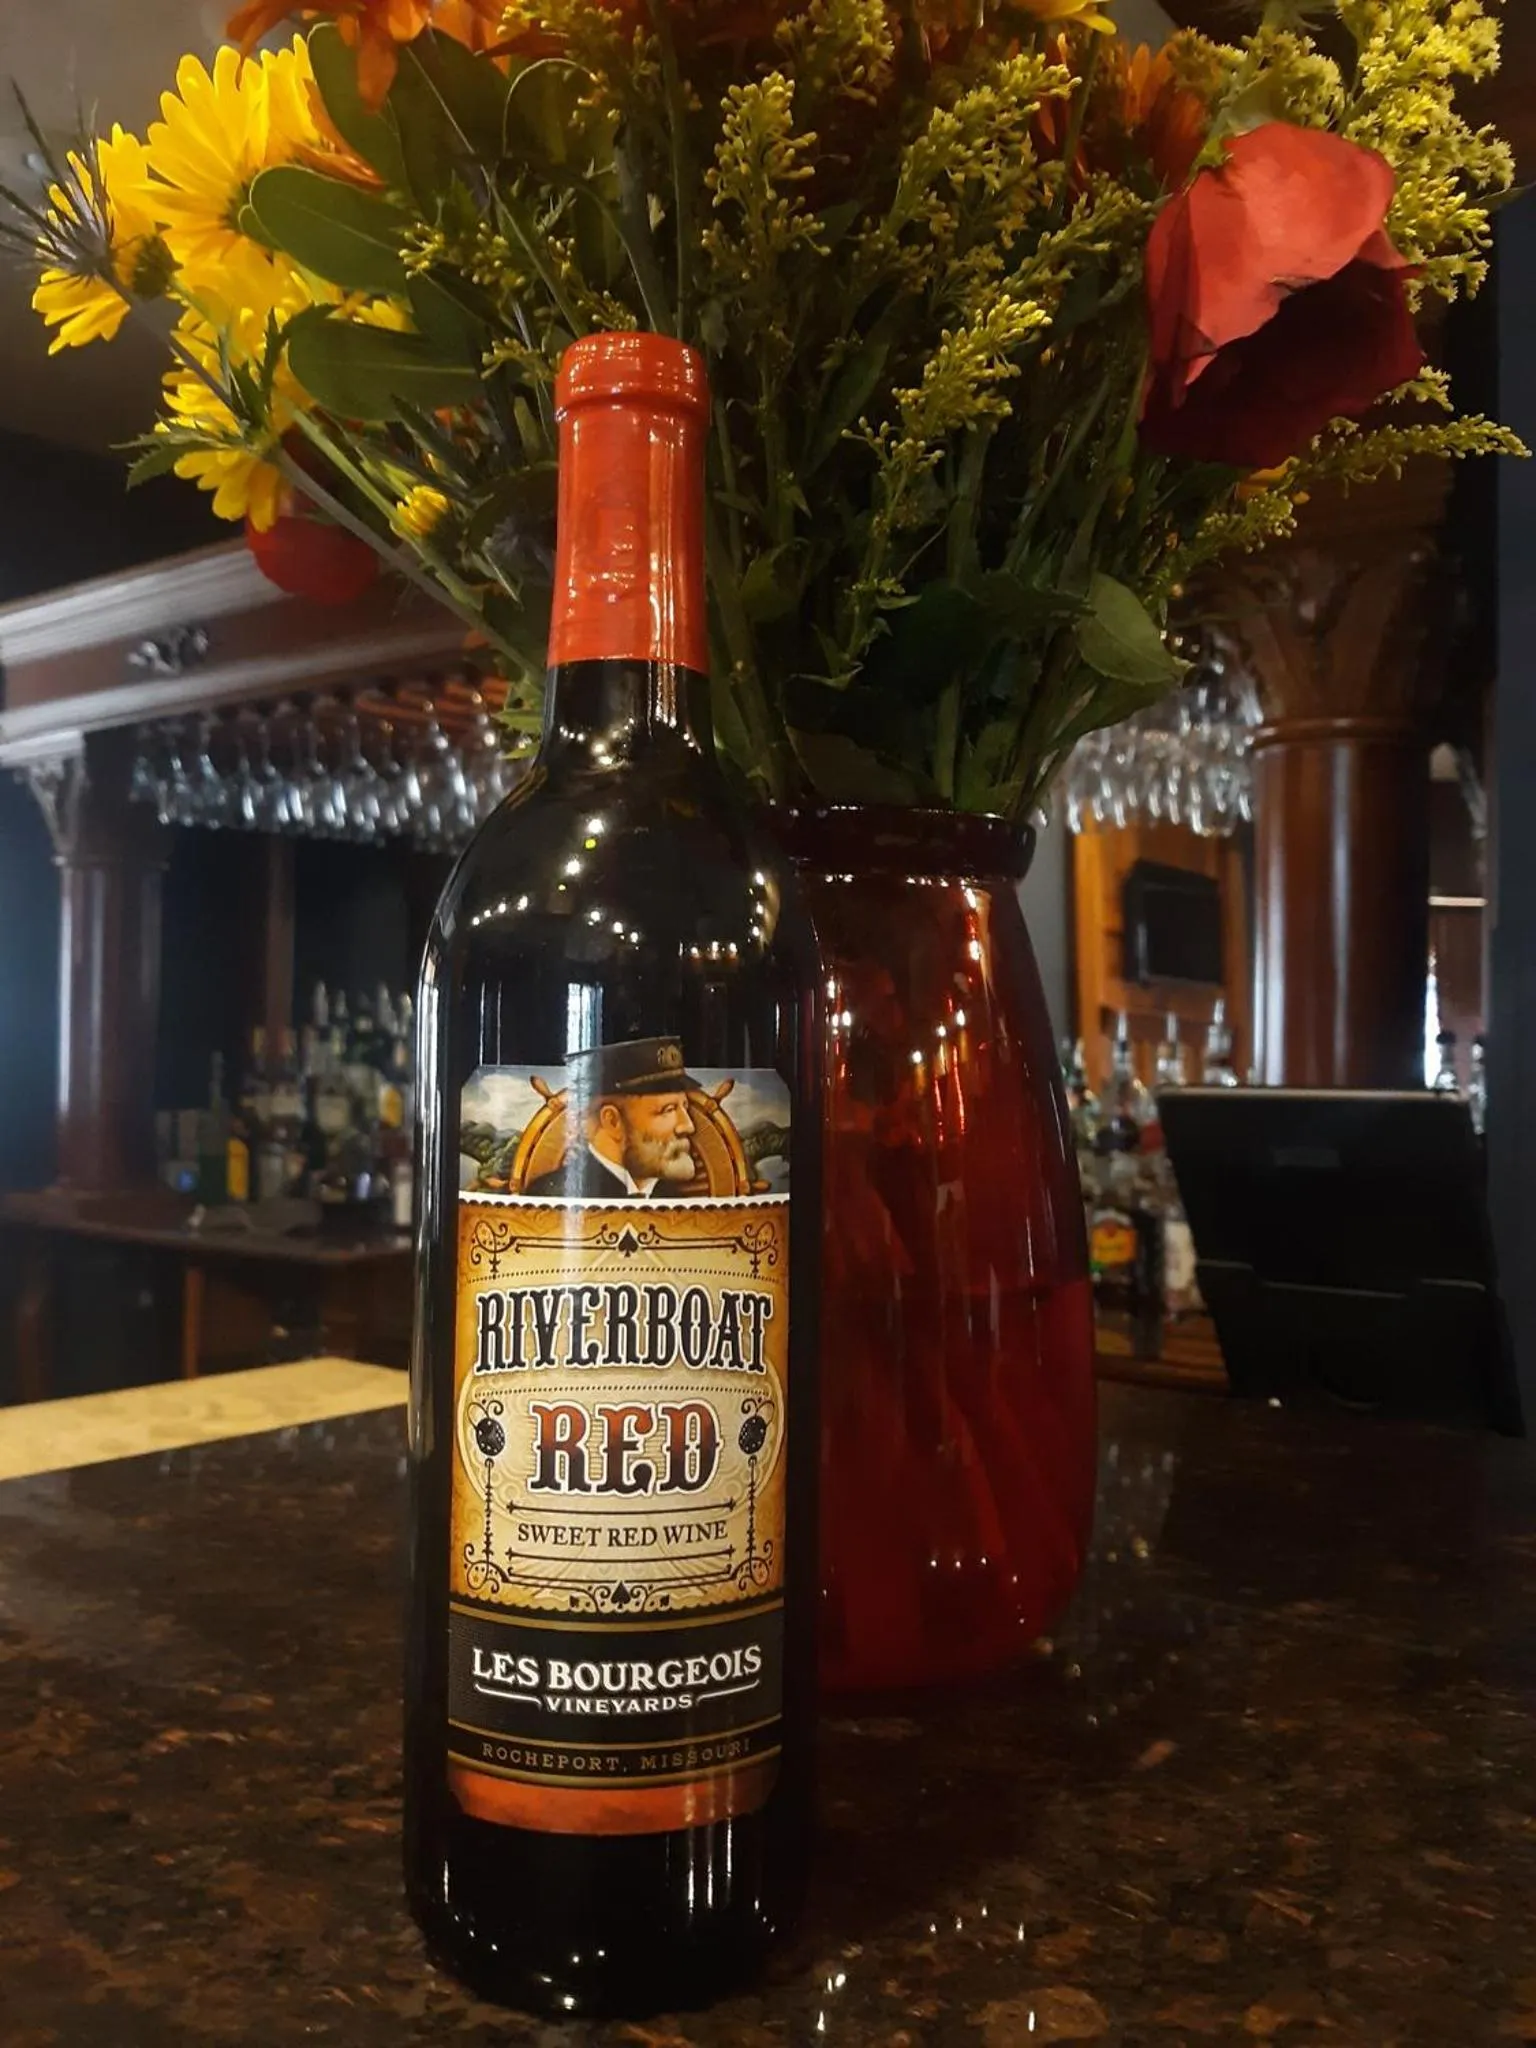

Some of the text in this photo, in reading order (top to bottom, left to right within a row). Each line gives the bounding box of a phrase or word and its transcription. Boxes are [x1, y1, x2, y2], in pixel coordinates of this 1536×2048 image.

[475, 1284, 772, 1373] RIVERBOAT
[529, 1400, 723, 1495] RED
[518, 1520, 729, 1547] SWEET RED WINE
[472, 1644, 762, 1692] LES BOURGEOIS
[546, 1694, 693, 1714] VINEYARDS
[482, 1739, 751, 1773] ROCHEPORT, MISSOURI
